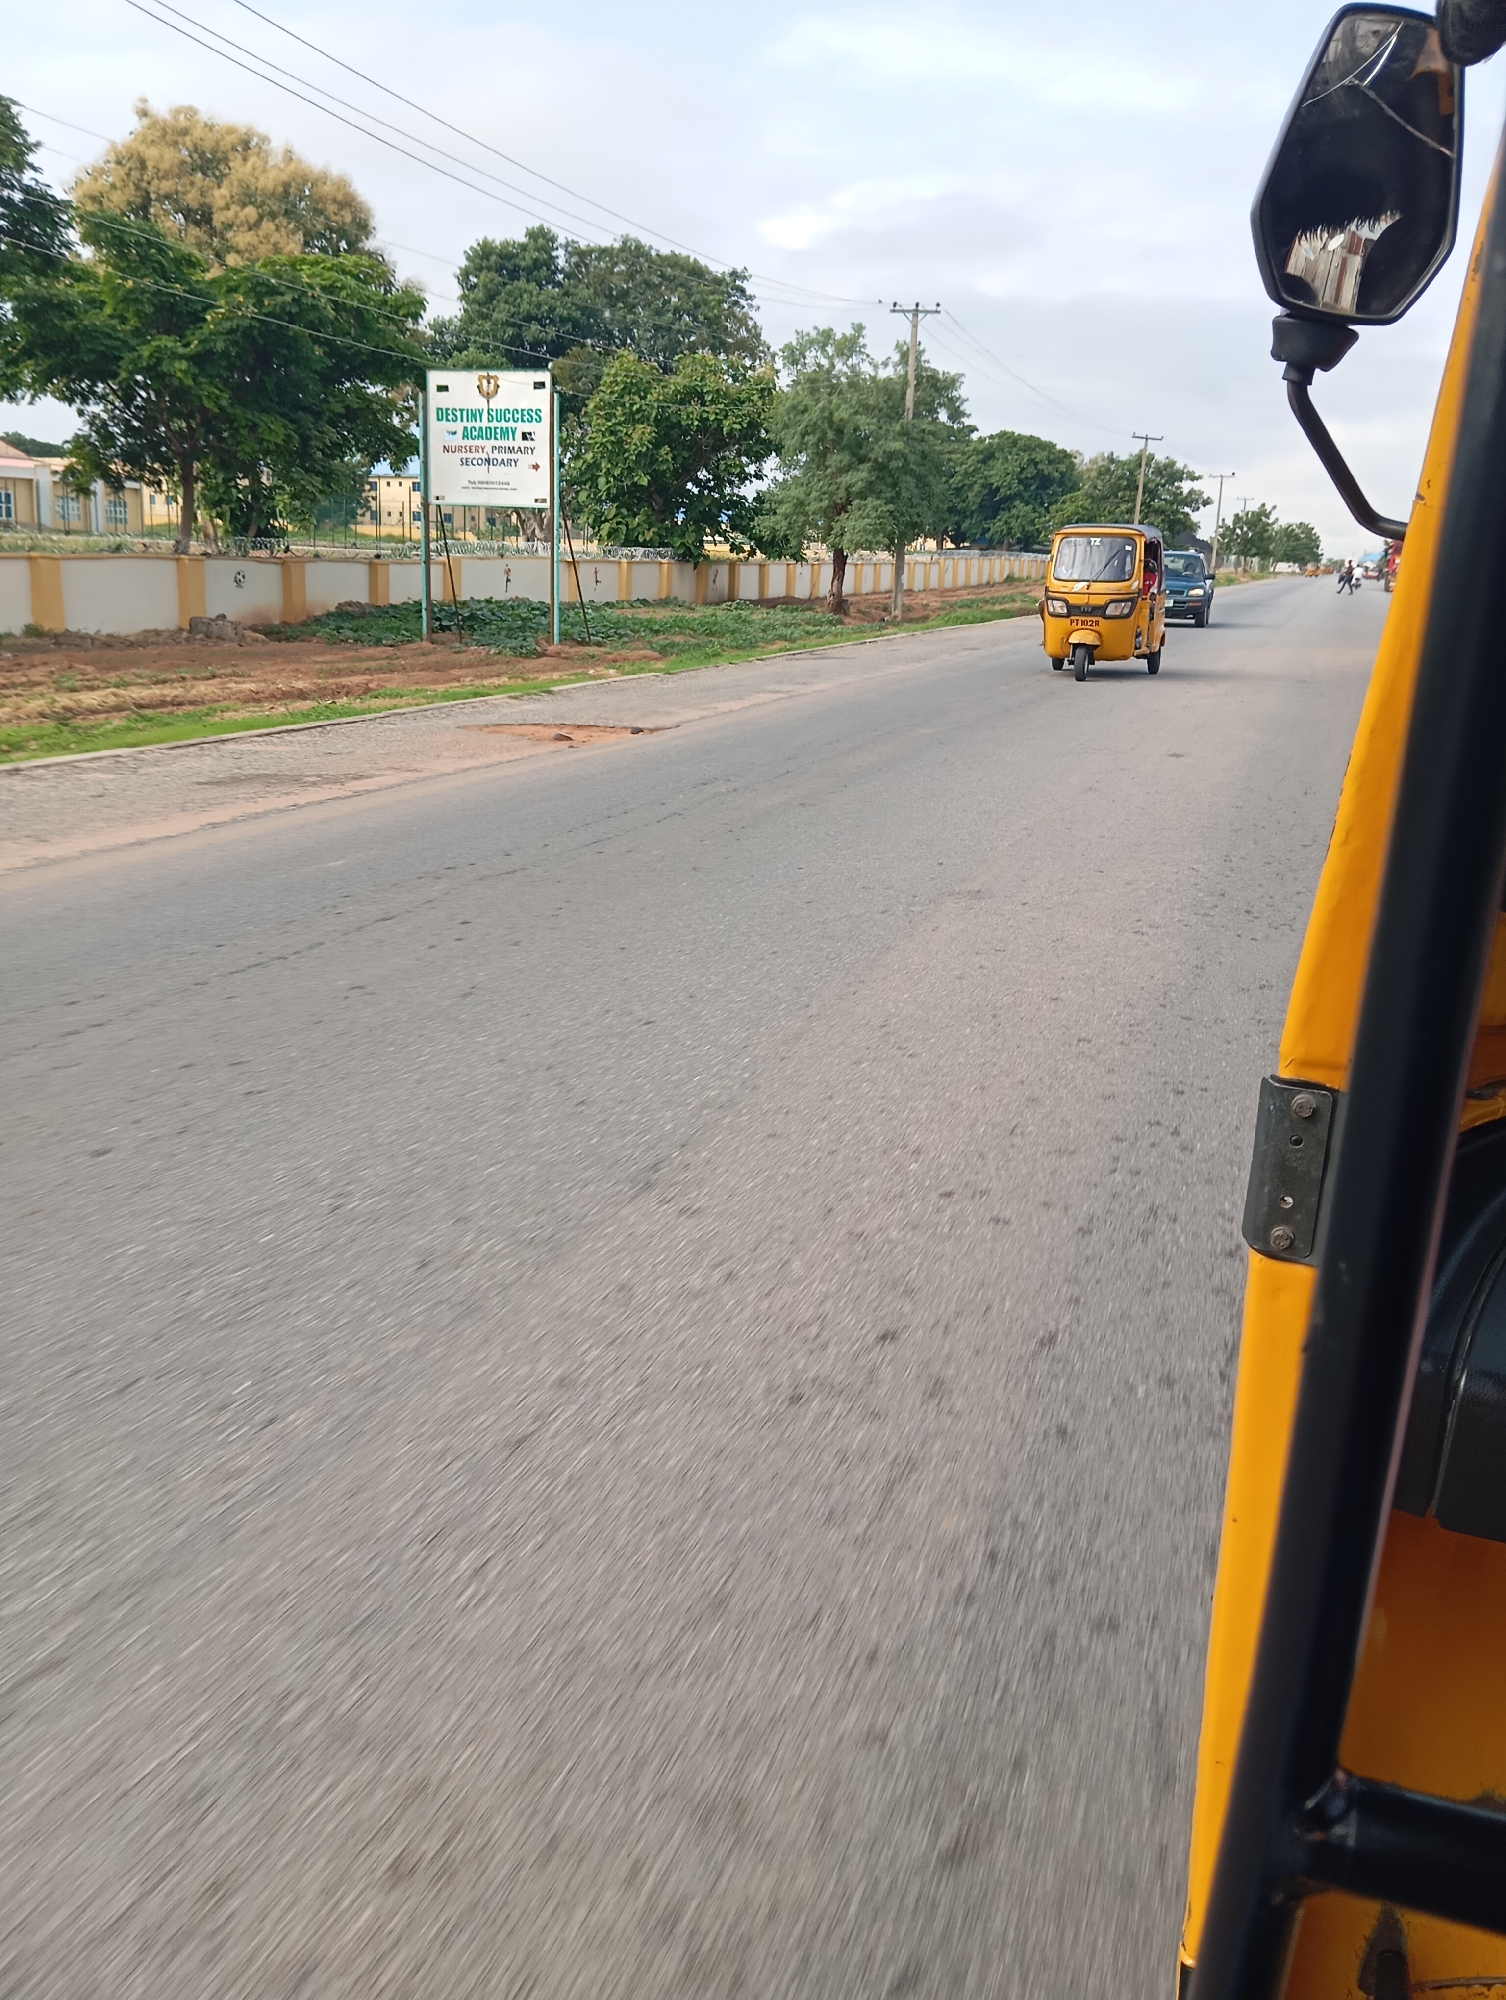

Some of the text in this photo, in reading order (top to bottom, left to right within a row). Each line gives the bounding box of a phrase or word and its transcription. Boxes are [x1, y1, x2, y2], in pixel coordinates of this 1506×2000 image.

[436, 407, 542, 423] DESTINY SUCCESS
[462, 426, 517, 441] ACADEMY
[491, 446, 535, 455] PRIMARY
[459, 458, 519, 467] SECONDARY
